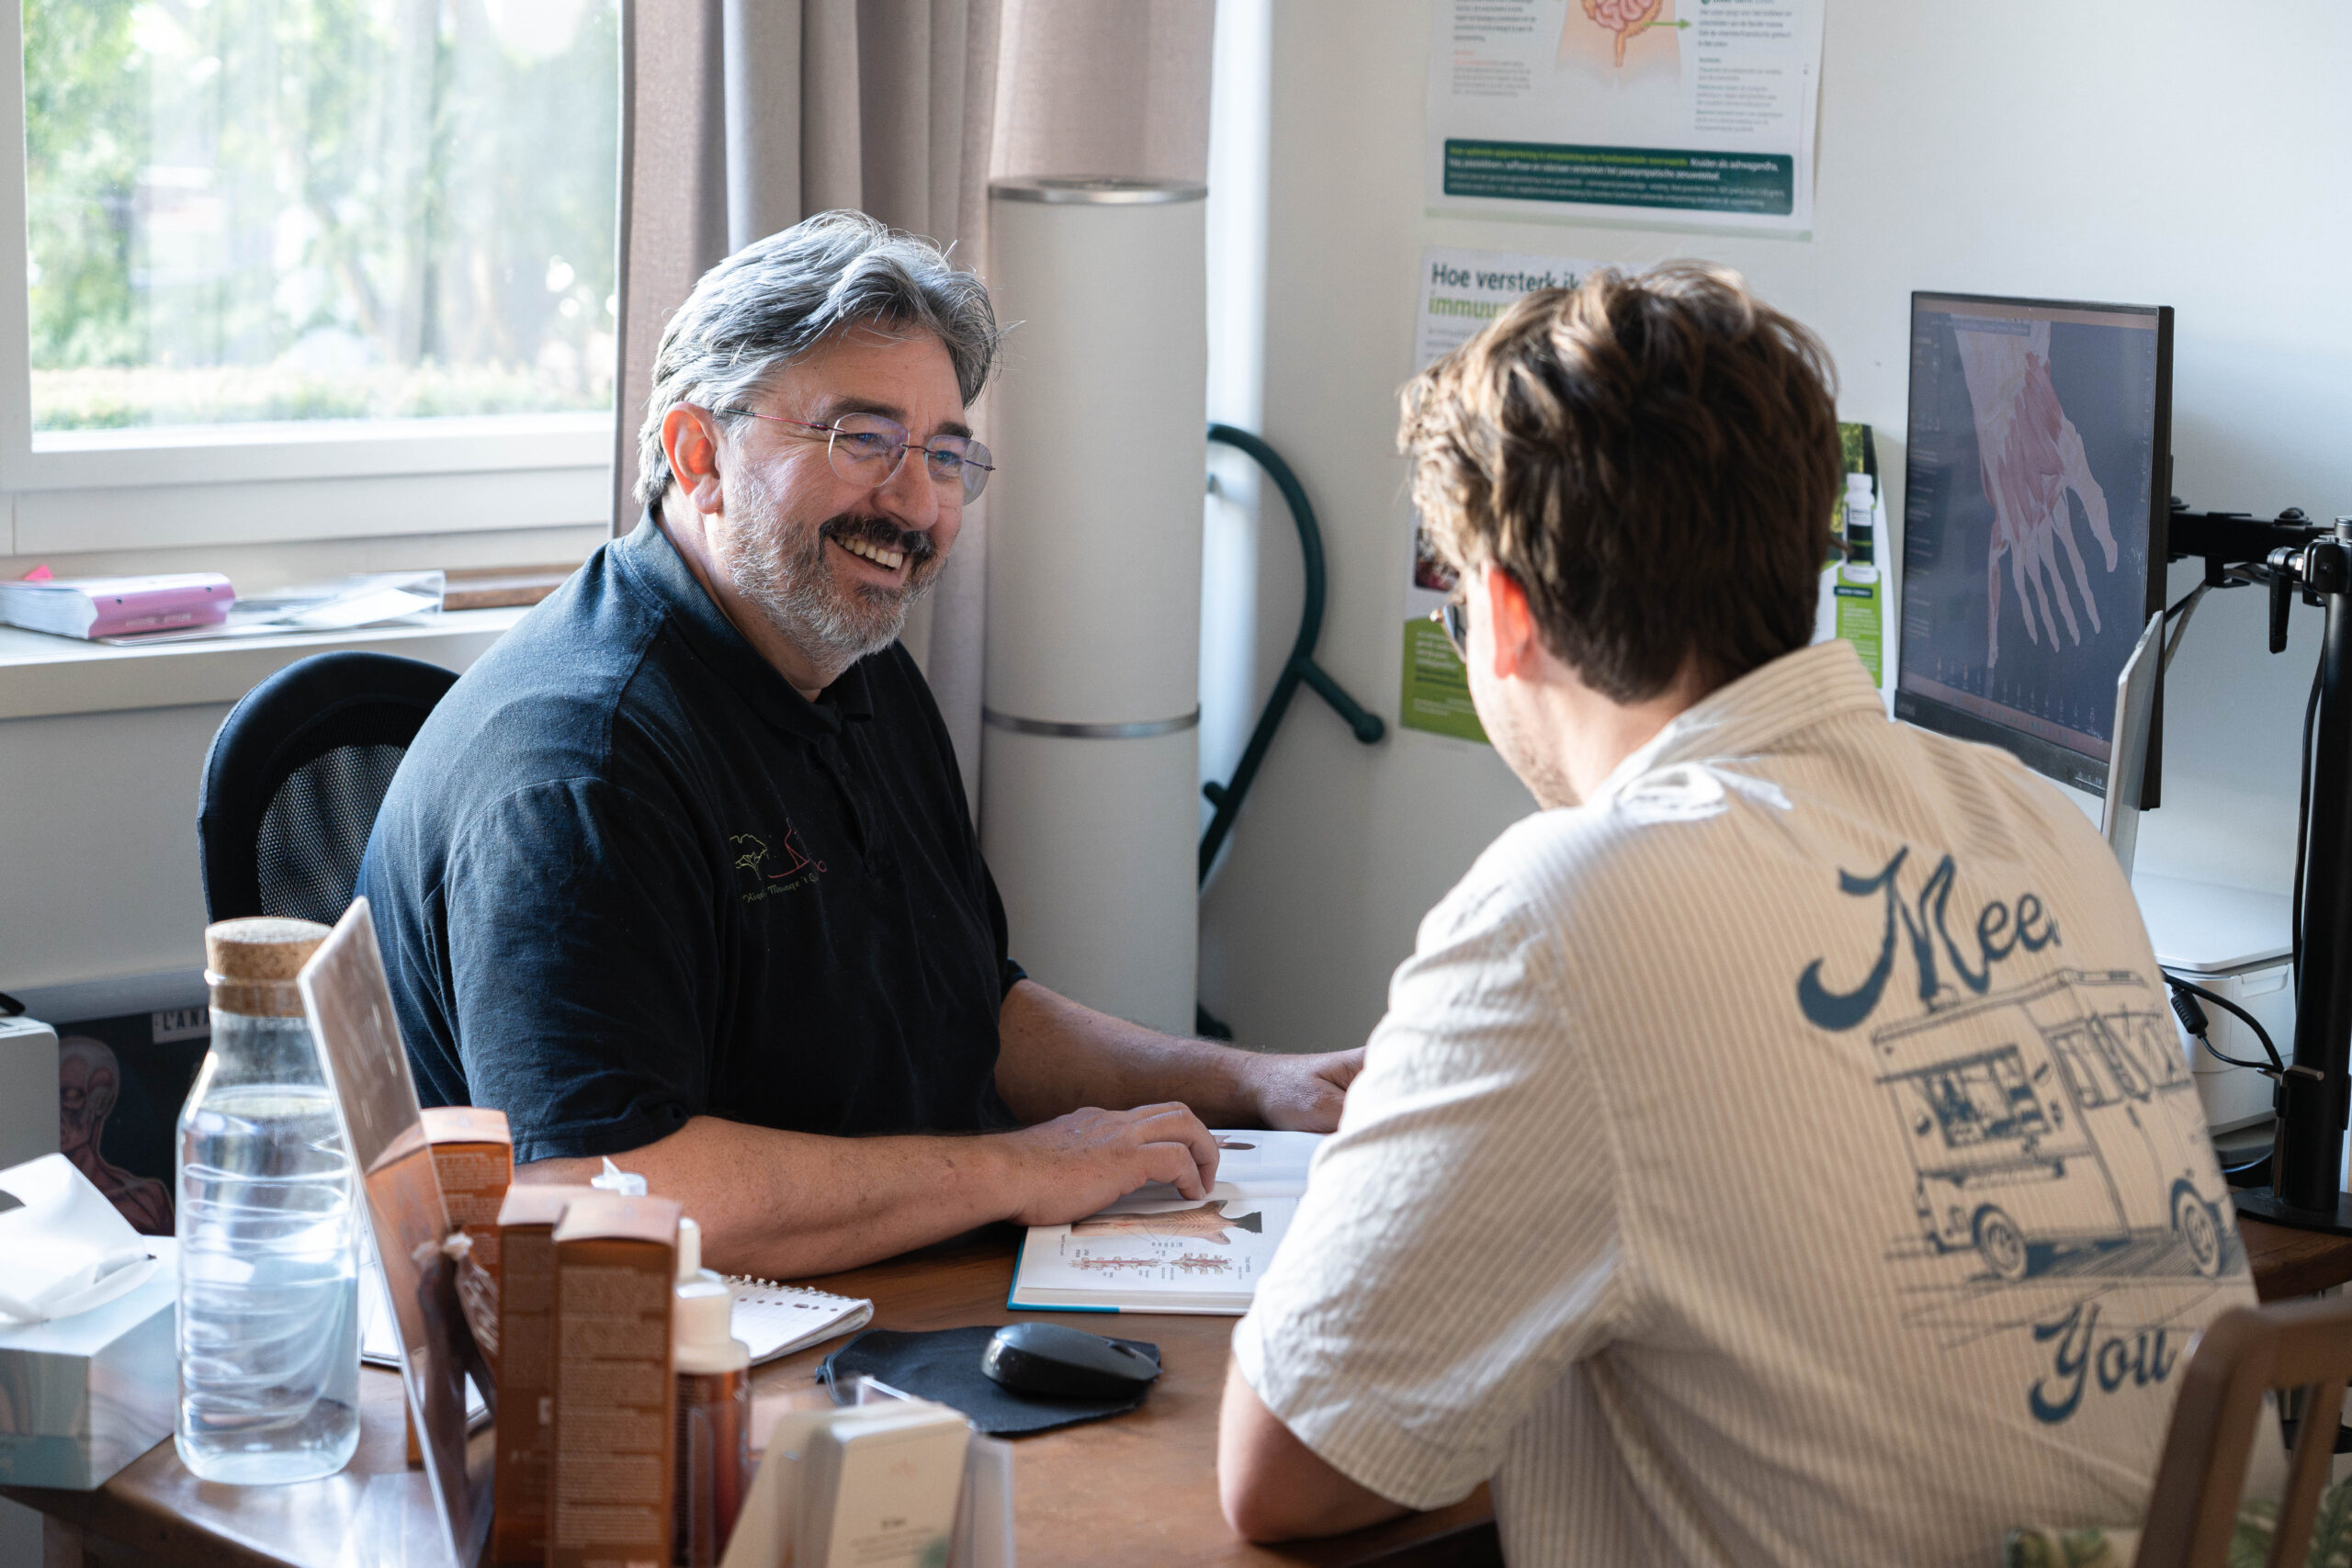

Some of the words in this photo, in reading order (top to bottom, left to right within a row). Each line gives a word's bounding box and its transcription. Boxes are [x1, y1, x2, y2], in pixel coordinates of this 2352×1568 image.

[1431, 262, 1470, 288] Hoe
[1476, 269, 1556, 293] versterk
[163, 1008, 209, 1031] L'AN
[2029, 1302, 2177, 1425] You
